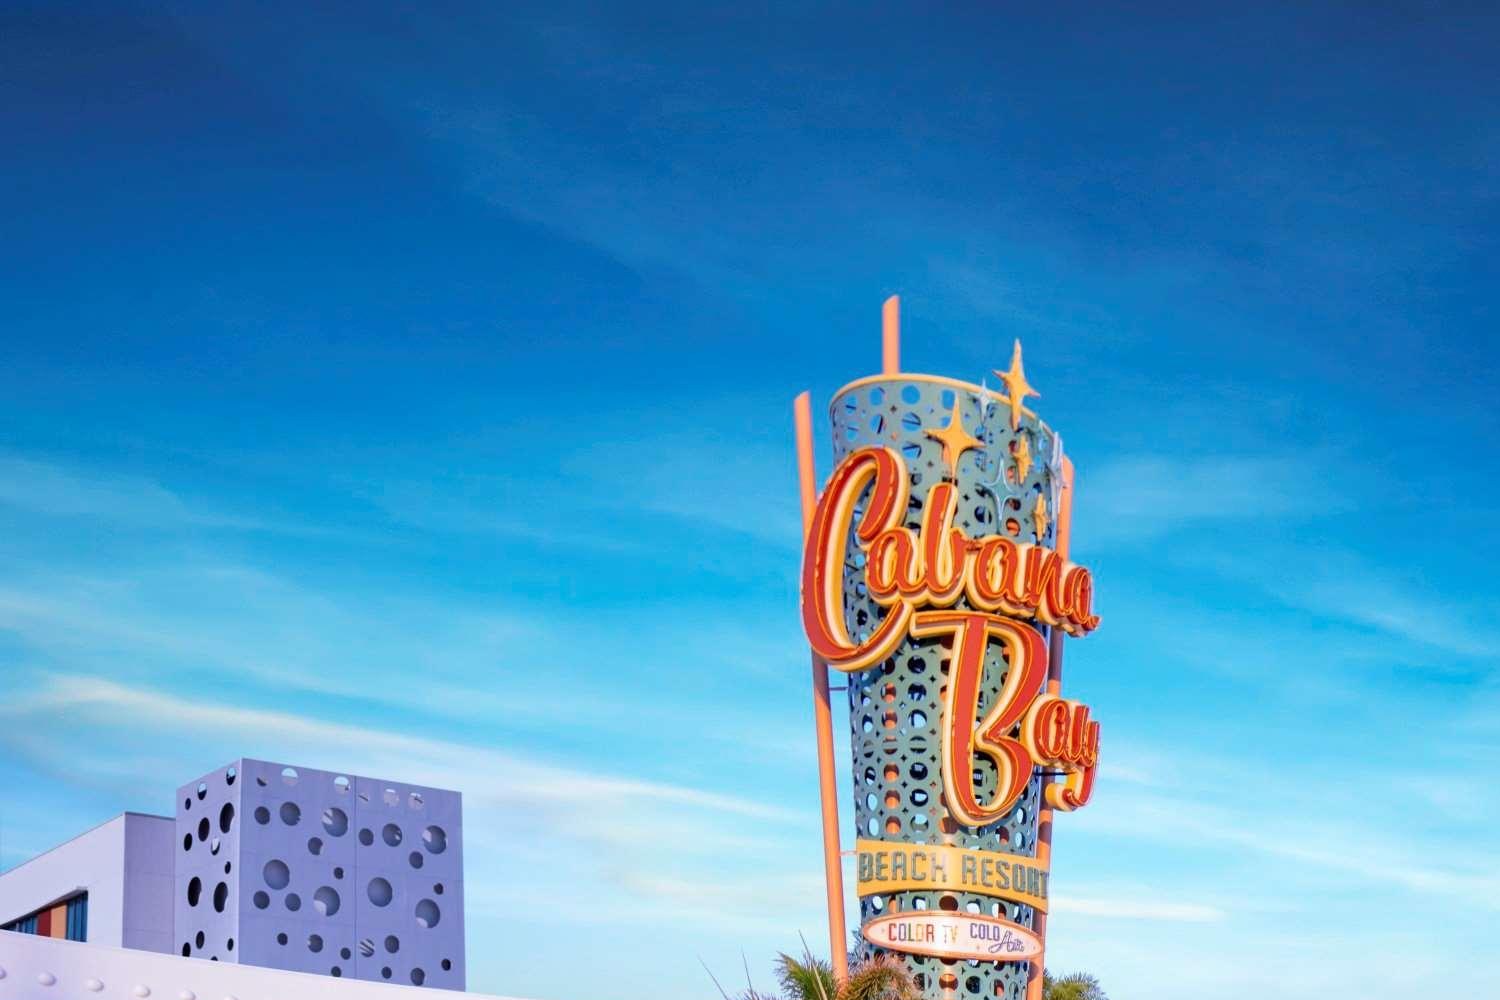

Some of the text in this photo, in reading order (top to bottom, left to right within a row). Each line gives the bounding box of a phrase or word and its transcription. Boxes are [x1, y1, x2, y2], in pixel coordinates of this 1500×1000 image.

[802, 446, 1101, 672] Cabana
[910, 610, 1101, 827] Bay
[858, 851, 1049, 900] BEACH RESORT
[888, 923, 935, 942] COLOR
[942, 925, 958, 944] TV
[970, 922, 1000, 941] COLD
